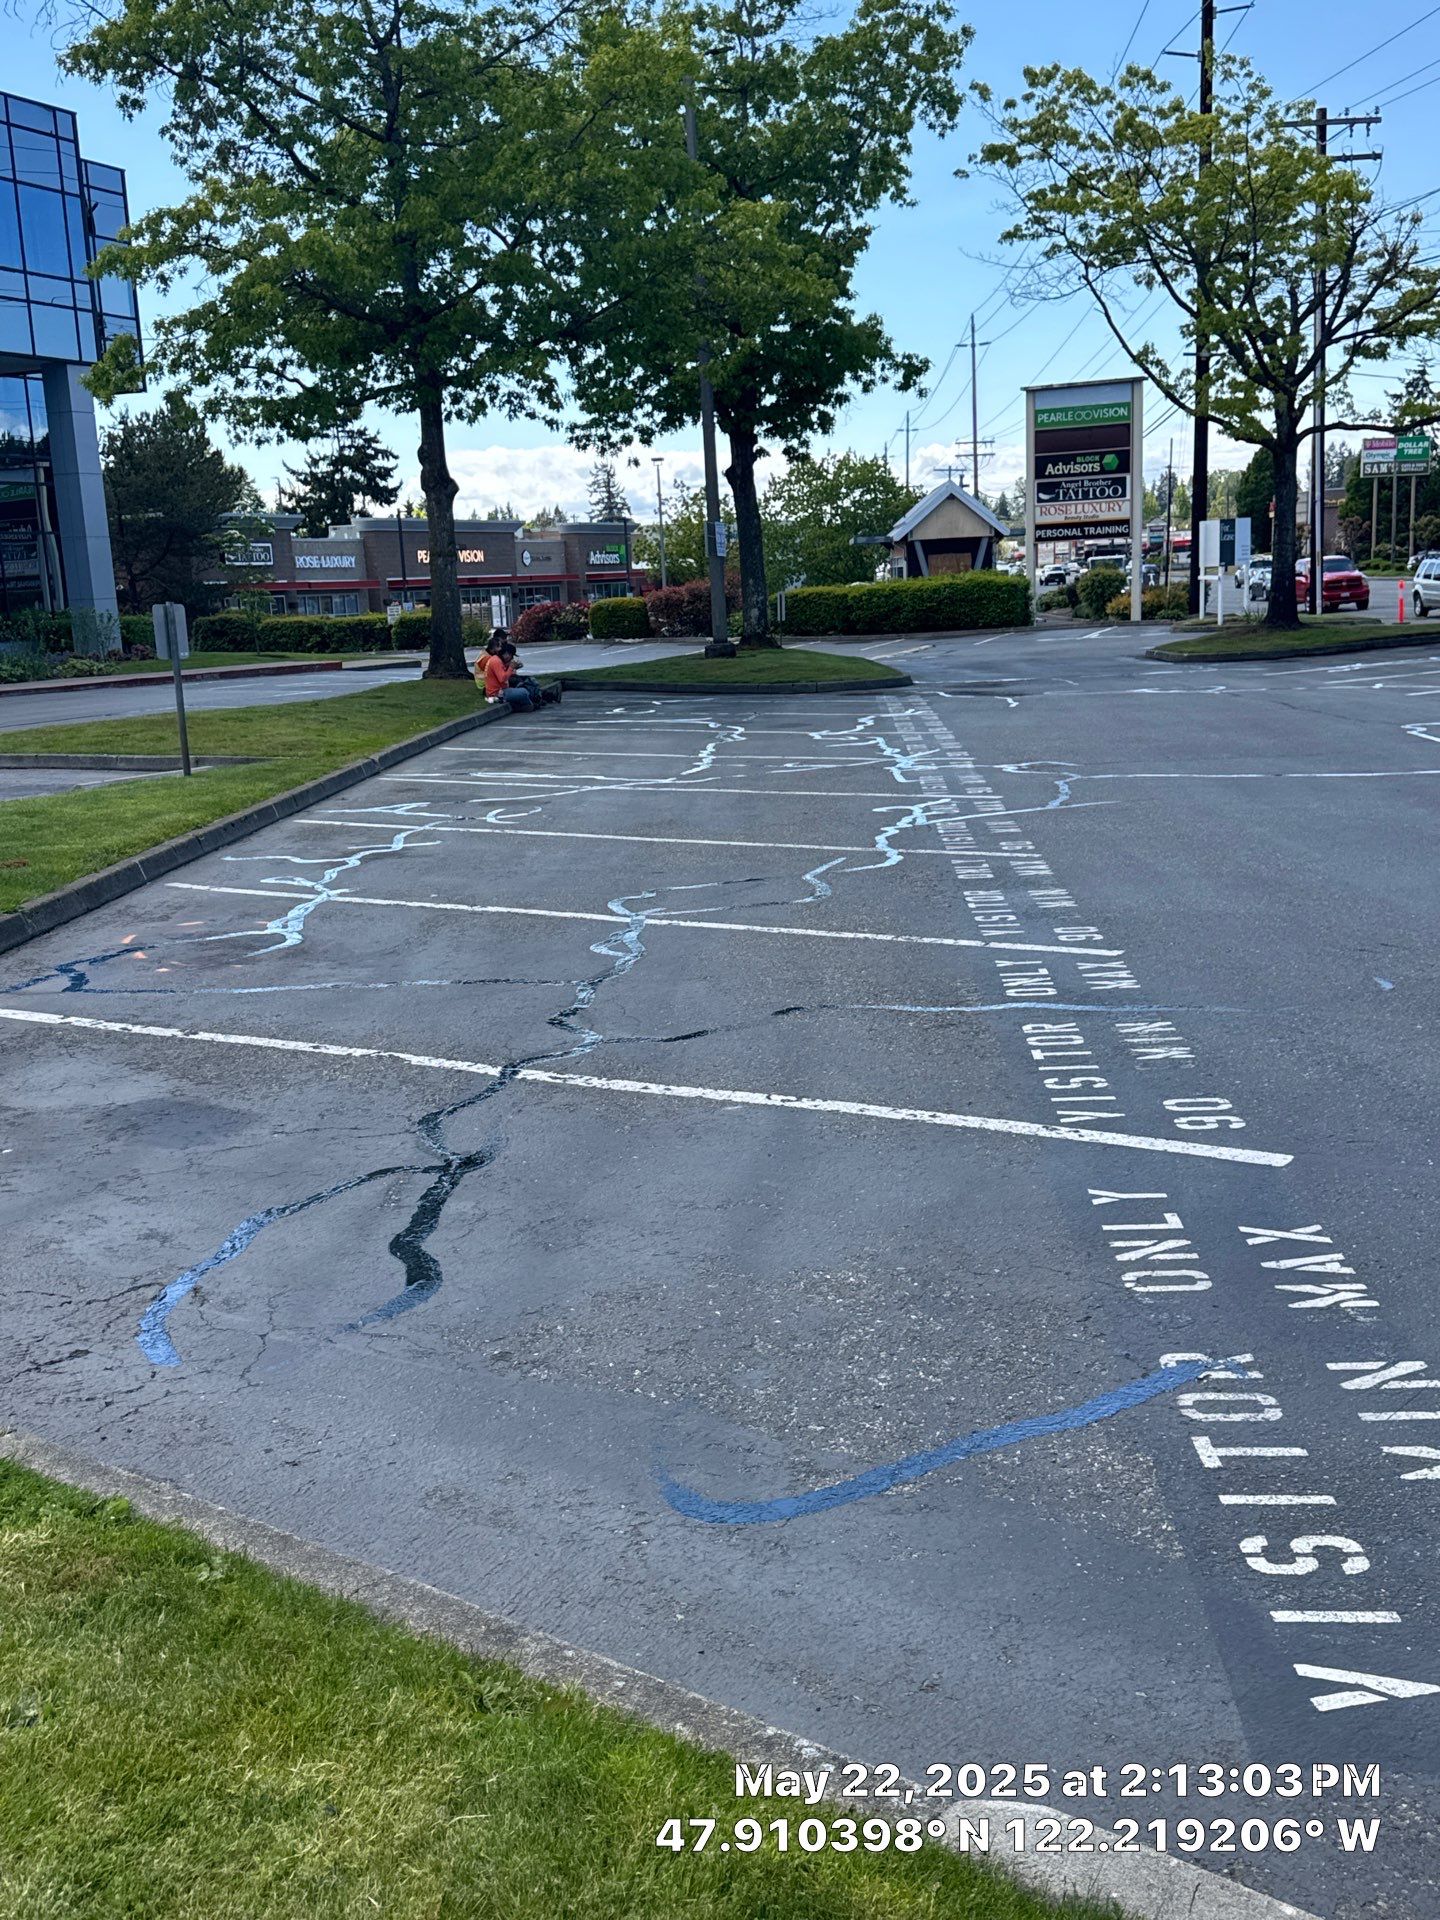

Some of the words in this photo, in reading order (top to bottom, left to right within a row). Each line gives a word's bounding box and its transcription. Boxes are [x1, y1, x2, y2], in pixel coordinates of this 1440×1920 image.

[1037, 411, 1074, 423] PEARLE
[1093, 406, 1128, 418] VISION
[1397, 441, 1429, 449] DOLLAR
[1045, 461, 1101, 476] Advisors
[1060, 479, 1082, 488] Angel
[1083, 479, 1112, 487] Brother
[1055, 485, 1122, 500] TATTOO
[1040, 503, 1072, 516] ROSE
[1074, 501, 1123, 514] LUXURY
[1035, 528, 1082, 538] PERSONAL
[1083, 525, 1129, 535] TRAINING
[295, 556, 320, 568] ROSE
[319, 555, 356, 568] LUXURY
[458, 549, 484, 562] VISION
[590, 550, 620, 565] Advisors
[950, 859, 995, 880] ONLY
[962, 890, 1025, 937] VISITOR
[1053, 926, 1103, 942] 90
[995, 960, 1058, 997] ONLY
[1075, 960, 1141, 990] MAX
[1114, 1021, 1196, 1060] MIN
[1022, 1022, 1126, 1124] VISITOR
[1162, 1097, 1247, 1131] 90
[1087, 1188, 1213, 1292] ONLY
[1238, 1224, 1380, 1309] MAX
[1158, 1352, 1440, 1712] VISITOR
